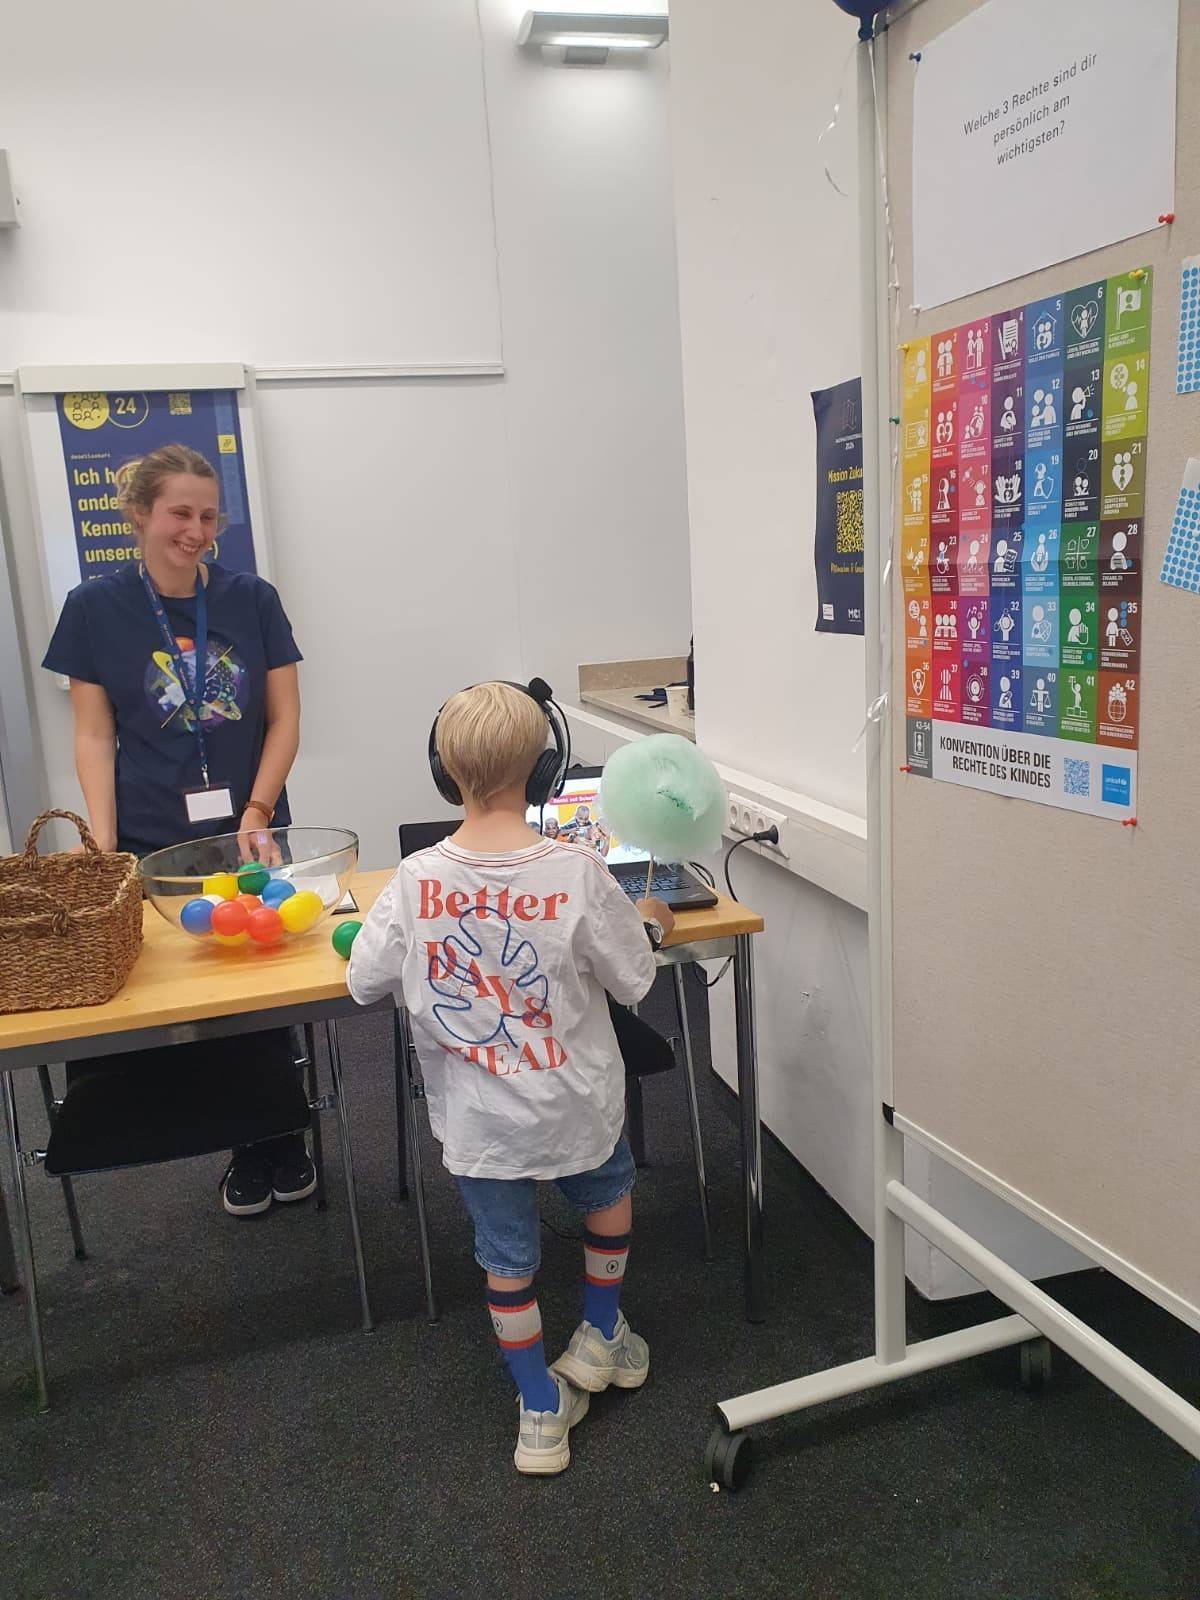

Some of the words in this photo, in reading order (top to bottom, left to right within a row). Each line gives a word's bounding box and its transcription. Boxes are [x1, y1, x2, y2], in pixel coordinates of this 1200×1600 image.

[963, 109, 1000, 136] Welche
[1002, 100, 1009, 115] 3
[1012, 83, 1050, 111] Rechte
[1053, 62, 1077, 88] sind
[1081, 52, 1098, 72] dir
[993, 105, 1049, 147] persönlich
[1053, 94, 1070, 113] am
[996, 120, 1065, 166] wichtigsten?
[1143, 272, 1149, 284] 7
[1097, 287, 1103, 299] 6
[1056, 299, 1061, 311] 5
[983, 322, 989, 333] 3
[1091, 368, 1100, 381] 13
[1051, 378, 1060, 390] 12
[1016, 386, 1023, 397] 11
[114, 397, 136, 415] 24
[1088, 448, 1098, 460] 20
[1132, 442, 1142, 454] 21
[1015, 459, 1022, 471] 18
[1051, 454, 1059, 465] 19
[828, 468, 848, 484] Mission
[849, 465, 863, 480] Zuku
[981, 464, 988, 475] 17
[73, 467, 100, 486] Ich
[78, 493, 120, 512] ande
[81, 520, 132, 537] Kenne
[1048, 529, 1057, 540] 26
[1086, 526, 1096, 538] 27
[1127, 523, 1138, 535] 28
[920, 538, 928, 547] 22
[949, 535, 957, 545] 23
[1013, 531, 1022, 542] 25
[950, 600, 957, 610] 30
[980, 600, 988, 610] 31
[1010, 601, 1020, 611] 32
[1047, 601, 1056, 612] 33
[1085, 602, 1095, 613] 34
[1127, 602, 1138, 613] 35
[951, 663, 958, 673] 37
[980, 666, 988, 676] 38
[1011, 669, 1020, 680] 39
[1046, 672, 1056, 683] 40
[1086, 674, 1095, 687] 41
[1124, 679, 1136, 691] 42
[915, 721, 930, 731] 43-54
[940, 736, 1001, 760] KONVENTION
[1001, 744, 1031, 766] ÜBER
[1033, 752, 1052, 770] DIE
[952, 755, 987, 776] RECHTE
[989, 763, 1007, 781] DES
[1010, 767, 1051, 789] KINDES
[1104, 776, 1121, 785] unicef
[416, 878, 569, 922] Better
[423, 941, 553, 1029] DAYS
